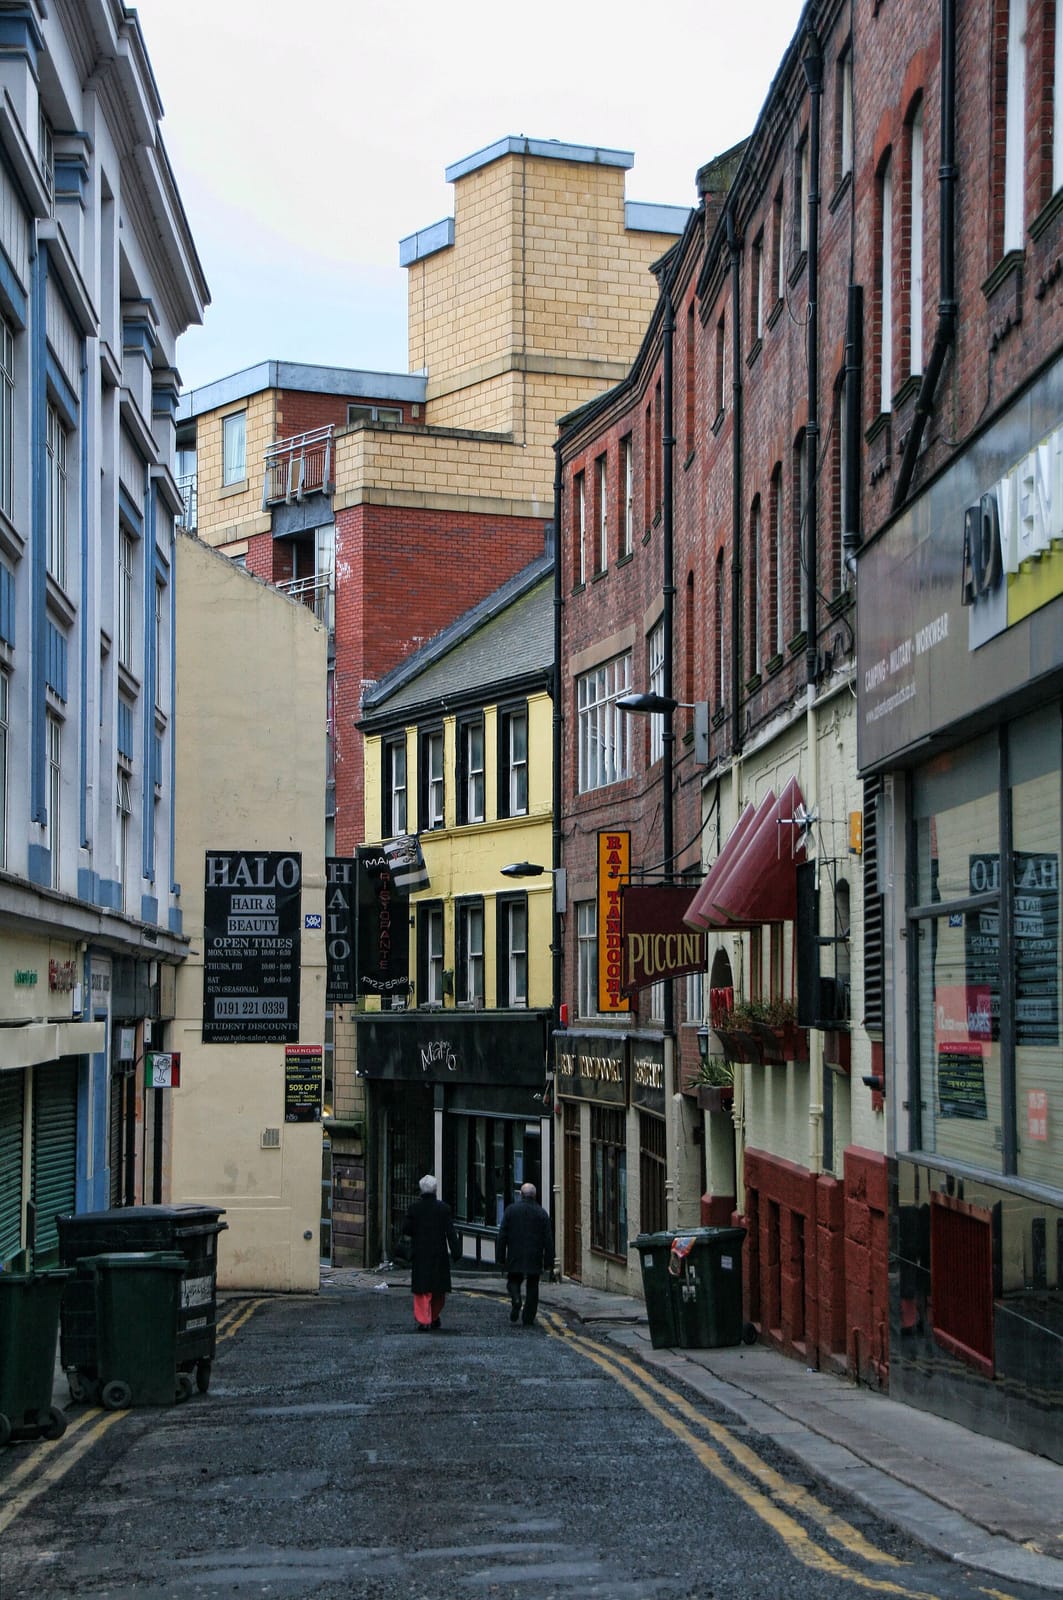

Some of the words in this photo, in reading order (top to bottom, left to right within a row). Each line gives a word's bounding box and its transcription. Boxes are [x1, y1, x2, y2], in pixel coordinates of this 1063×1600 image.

[864, 658, 886, 693] CAMPING
[889, 638, 912, 674] MILITARY
[914, 612, 949, 656] WORKWEAR
[606, 836, 622, 879] RAJ
[206, 856, 300, 888] HALO
[232, 898, 263, 910] HAIR
[265, 898, 276, 910] &
[327, 863, 352, 960] HALO
[228, 919, 278, 932] BEAUTY
[213, 937, 249, 948] OPEN
[252, 938, 293, 949] TIMES
[606, 890, 622, 1008] TANDOORI
[628, 933, 702, 985] PUCCINI
[207, 985, 222, 993] SUN
[217, 1001, 240, 1015] 0191
[242, 1001, 262, 1015] 221
[262, 1001, 285, 1015] 0339
[204, 1022, 247, 1031] STUDENT
[248, 1022, 298, 1031] DISCOUNTS
